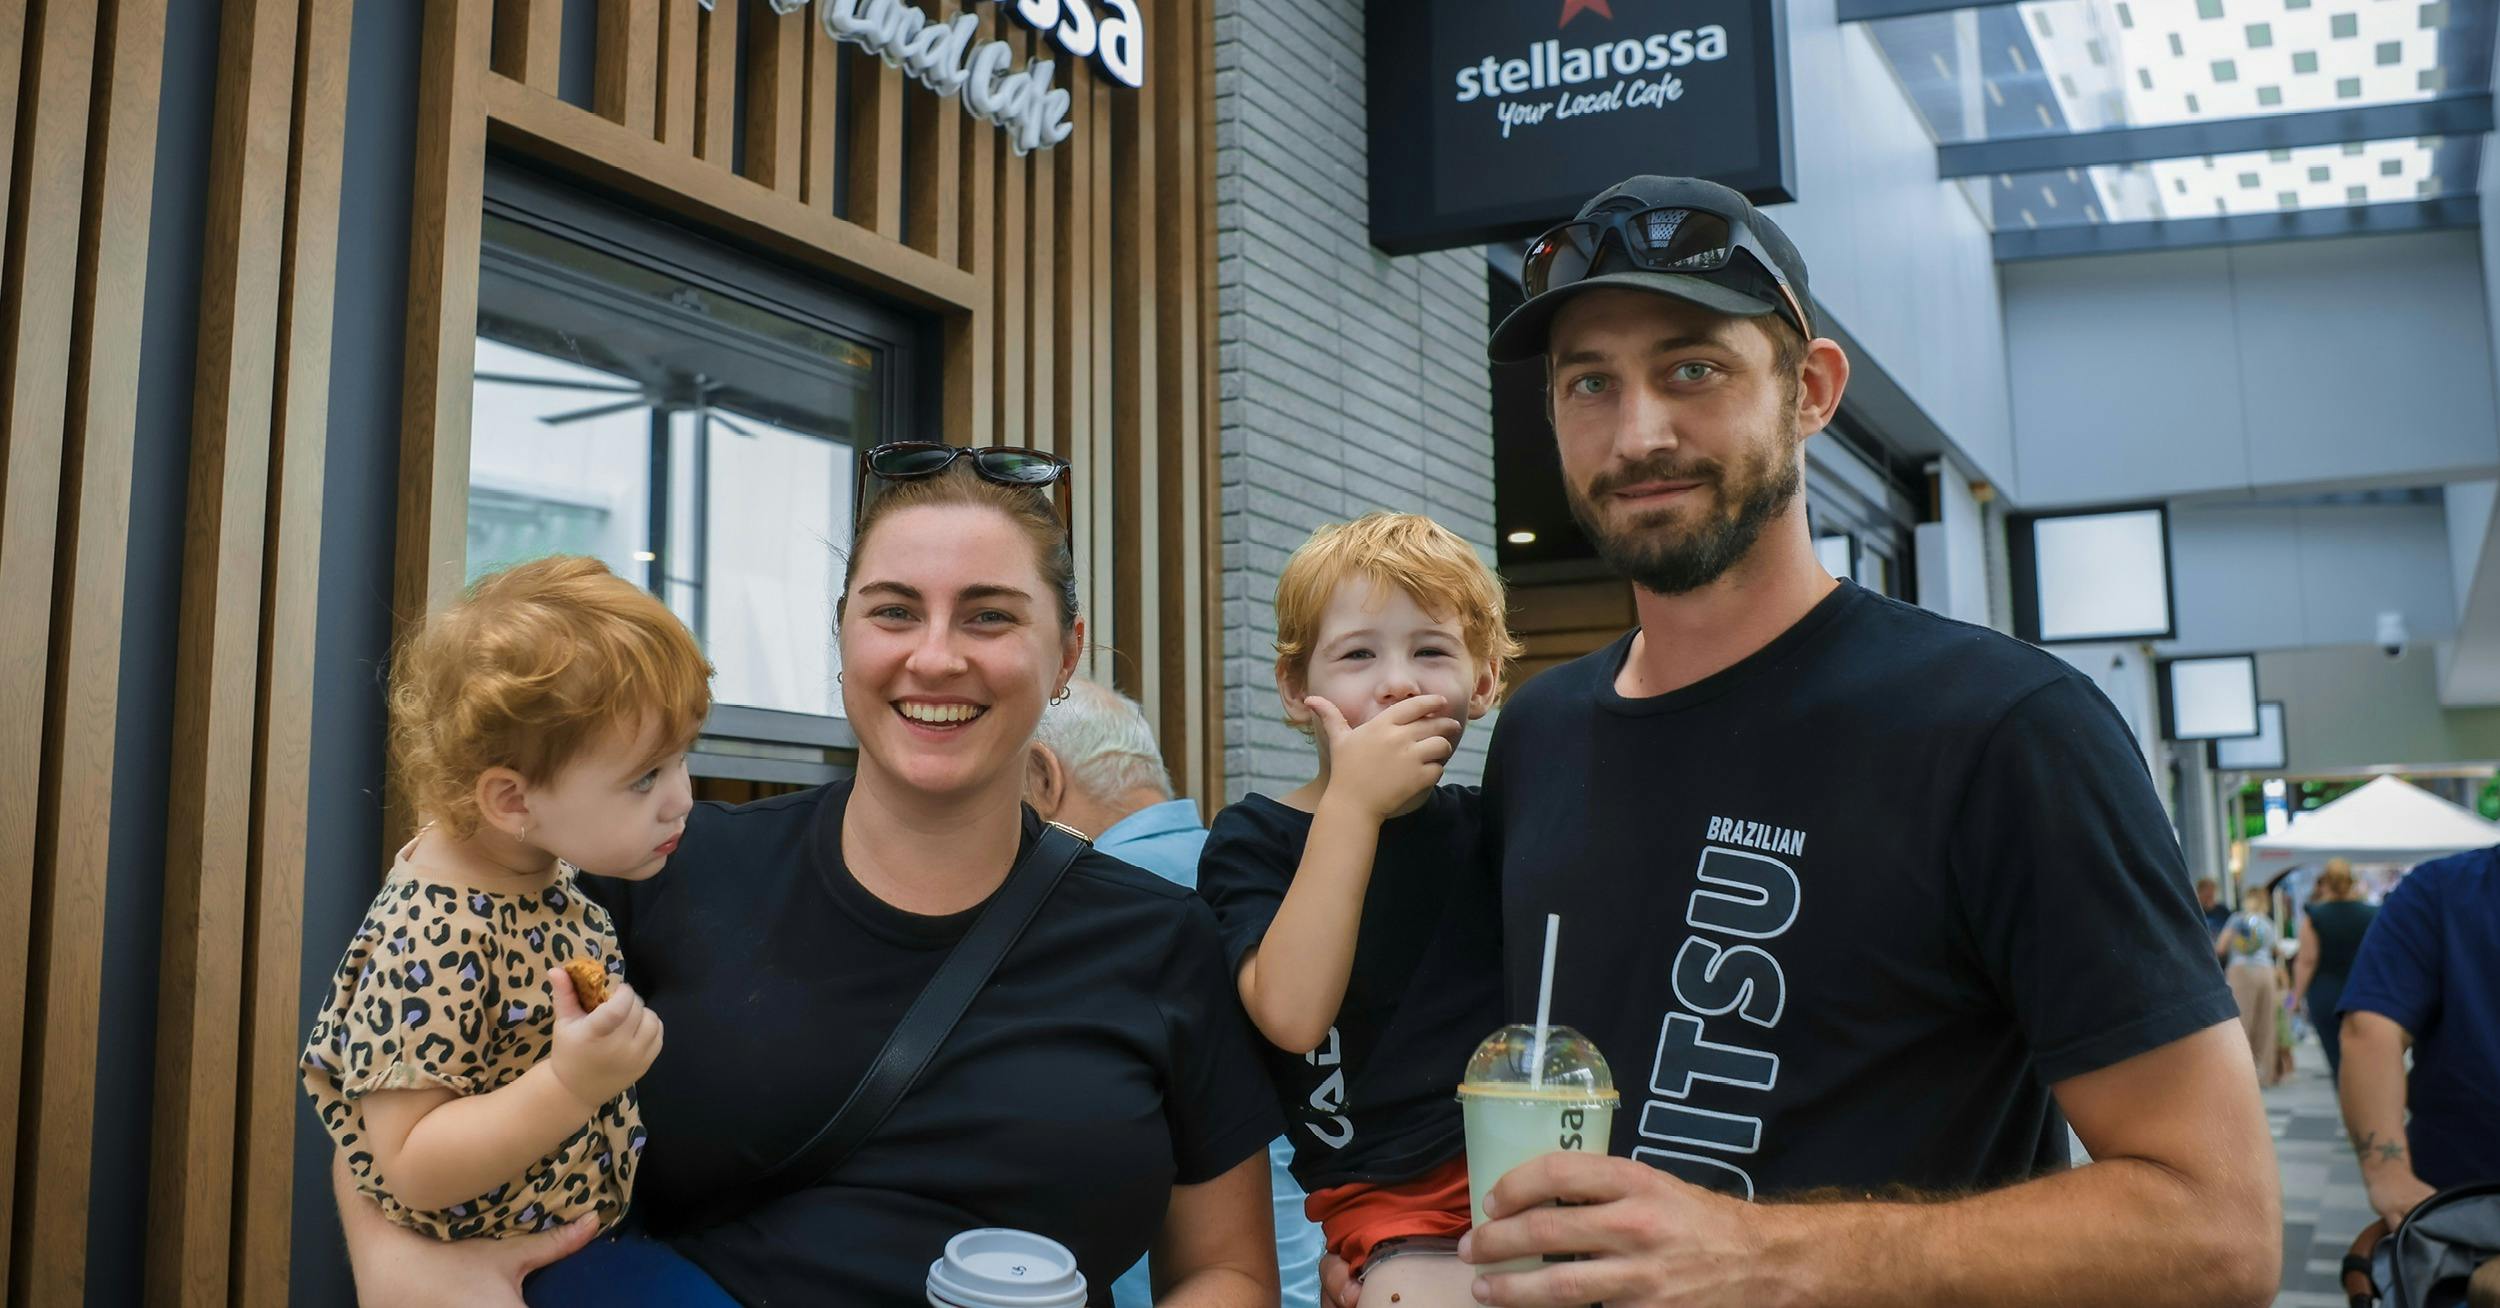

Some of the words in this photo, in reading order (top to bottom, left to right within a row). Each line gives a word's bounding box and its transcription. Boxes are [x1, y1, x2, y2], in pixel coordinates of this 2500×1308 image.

[963, 40, 1073, 155] Cafe
[1455, 24, 1728, 102] stellarossa
[1498, 101, 1554, 138] Your
[1555, 79, 1626, 120] Local
[1625, 72, 1684, 109] Cafe
[1706, 815, 1807, 857] BRAZILIAN
